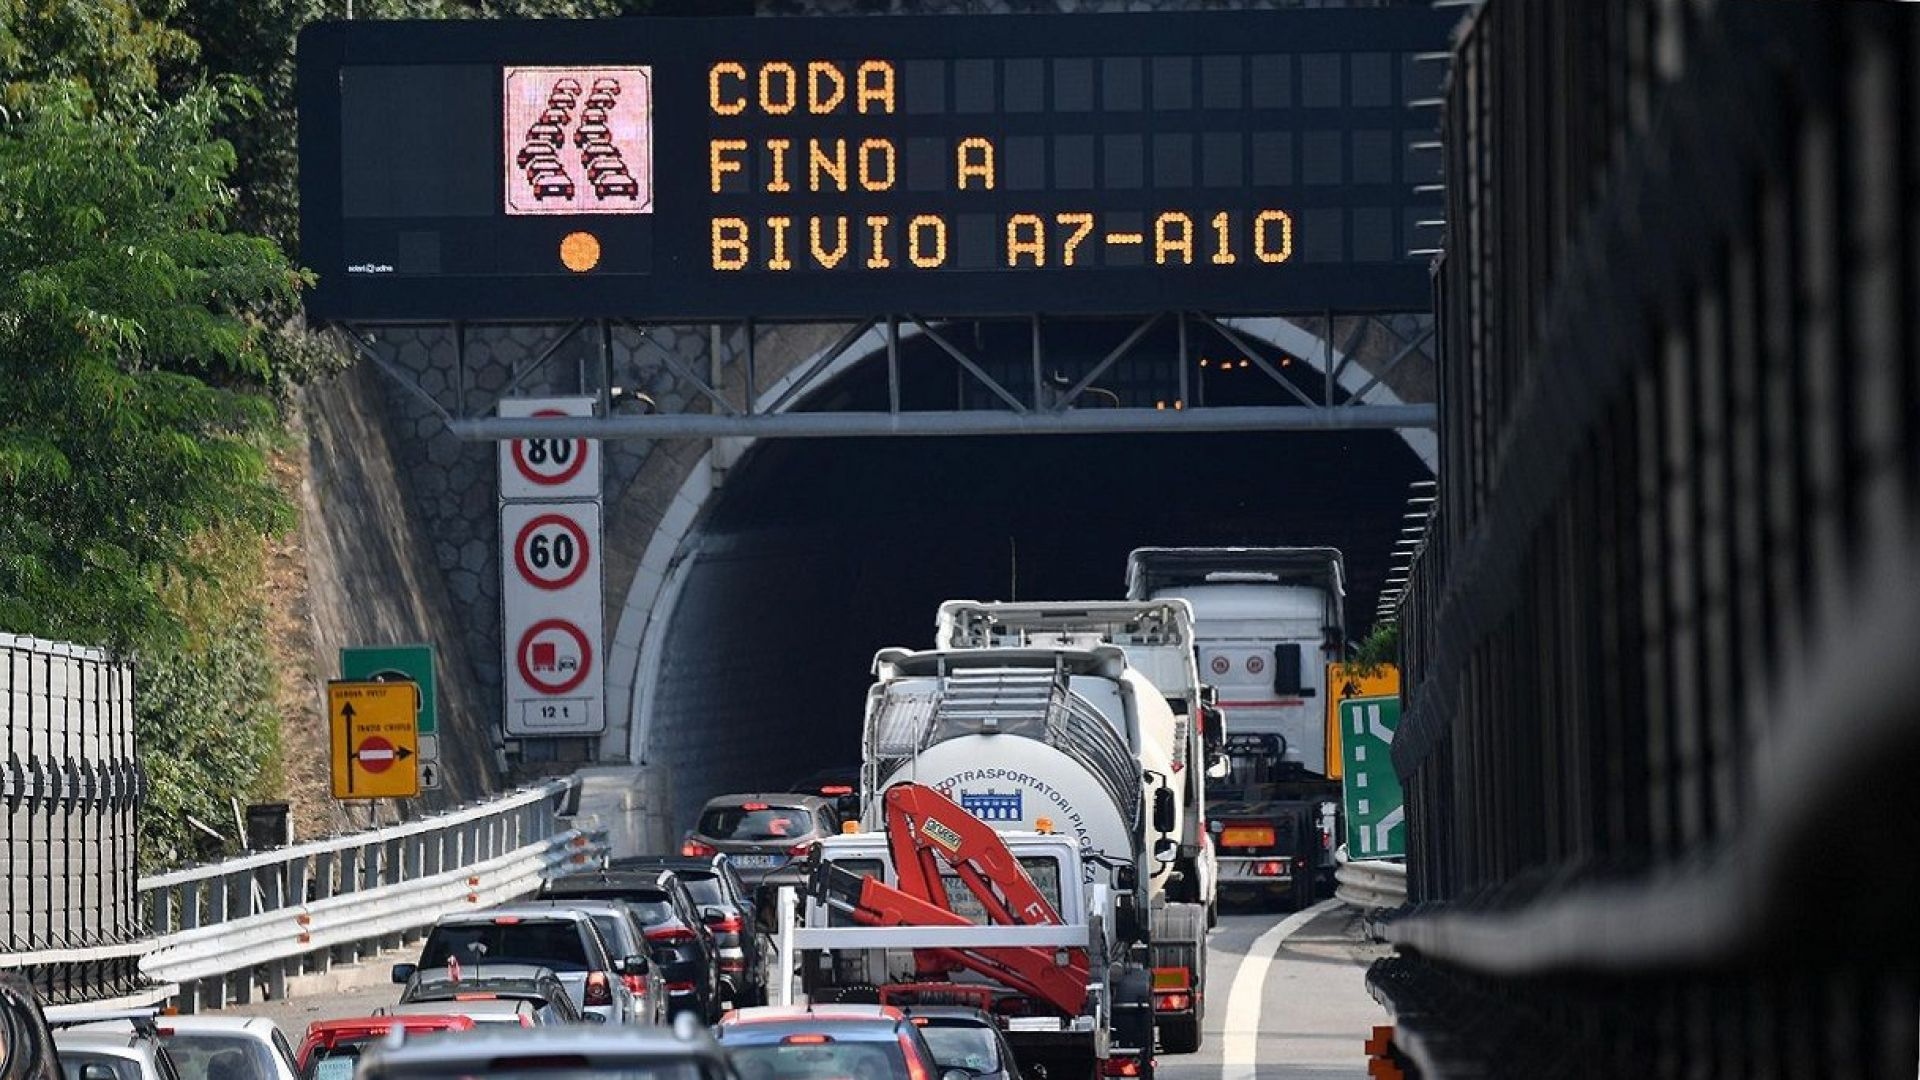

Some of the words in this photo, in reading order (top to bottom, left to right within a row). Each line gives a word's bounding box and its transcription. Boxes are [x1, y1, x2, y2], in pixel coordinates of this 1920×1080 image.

[709, 61, 896, 115] CODA
[710, 138, 897, 193] FINO
[957, 136, 994, 190] A
[711, 215, 946, 271] BIVIO
[1007, 210, 1293, 267] A7-A10
[529, 438, 571, 465] 80
[530, 533, 574, 569] 60
[542, 705, 557, 718] 12
[934, 768, 1073, 814] TOTRASPORTATORI
[1068, 812, 1097, 886] PIACEZA
